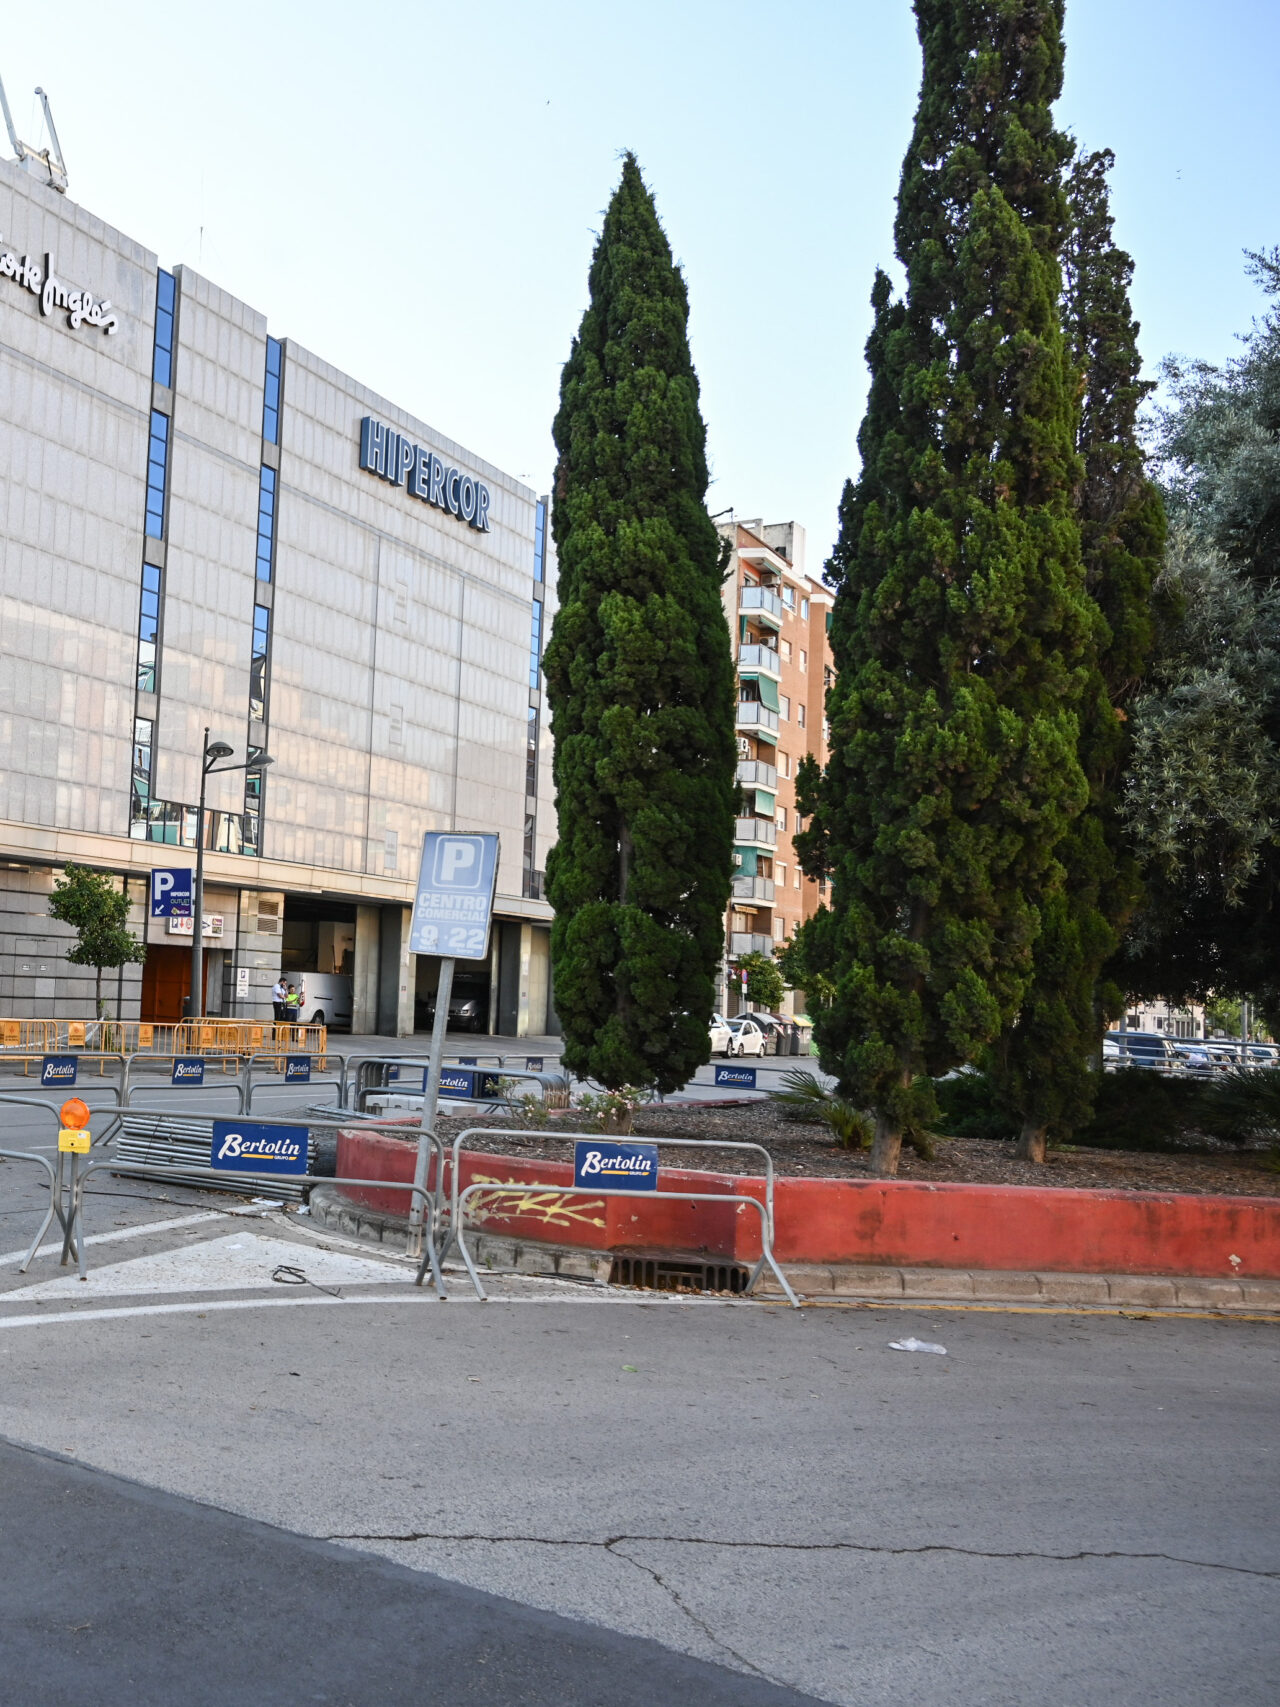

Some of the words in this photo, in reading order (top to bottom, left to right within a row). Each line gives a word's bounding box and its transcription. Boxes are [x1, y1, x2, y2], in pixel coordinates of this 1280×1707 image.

[359, 416, 491, 533] HIPERCOR
[441, 841, 476, 881] P
[154, 872, 175, 900] P
[418, 892, 487, 911] CENTRO
[417, 907, 486, 923] COMERCIAL
[420, 925, 439, 946] 9
[448, 927, 484, 950] 22
[43, 1063, 75, 1080] Bertolín
[439, 1077, 469, 1088] ertolín
[218, 1133, 301, 1160] Bertolín
[581, 1151, 652, 1177] Bertolín
